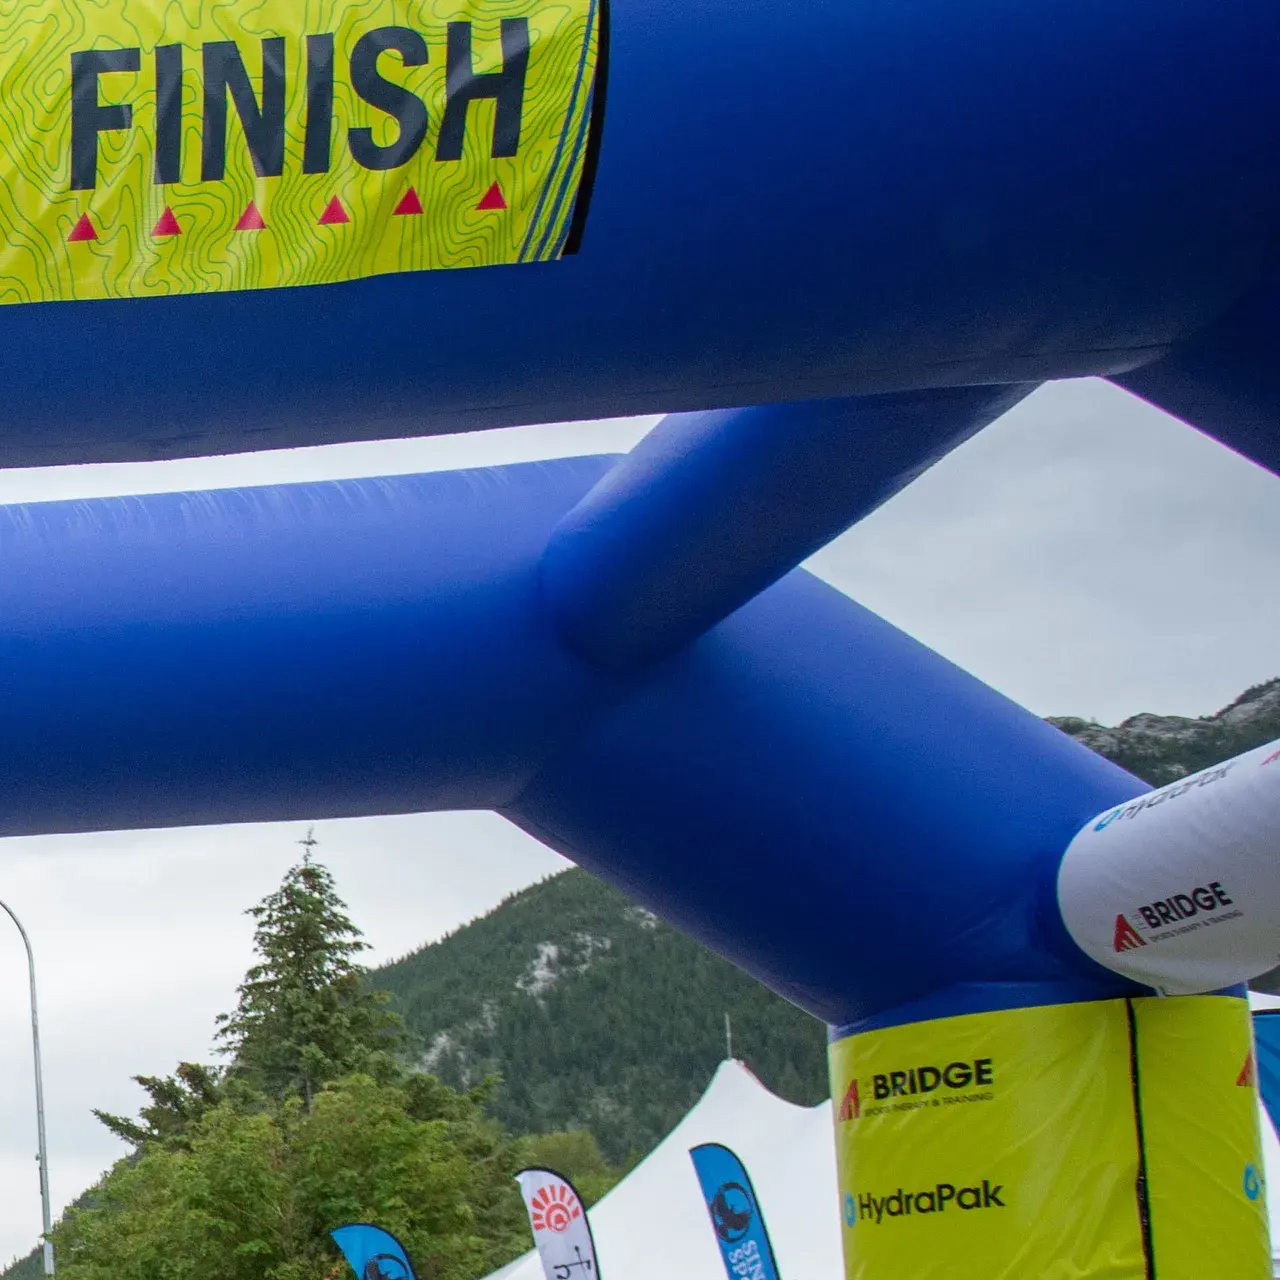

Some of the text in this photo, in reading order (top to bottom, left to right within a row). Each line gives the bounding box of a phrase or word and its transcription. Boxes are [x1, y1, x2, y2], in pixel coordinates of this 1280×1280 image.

[69, 17, 529, 191] FINISH
[1139, 881, 1234, 929] BRIDGE
[873, 1058, 994, 1100] BRIDGE
[858, 1180, 1006, 1225] HydraPak
